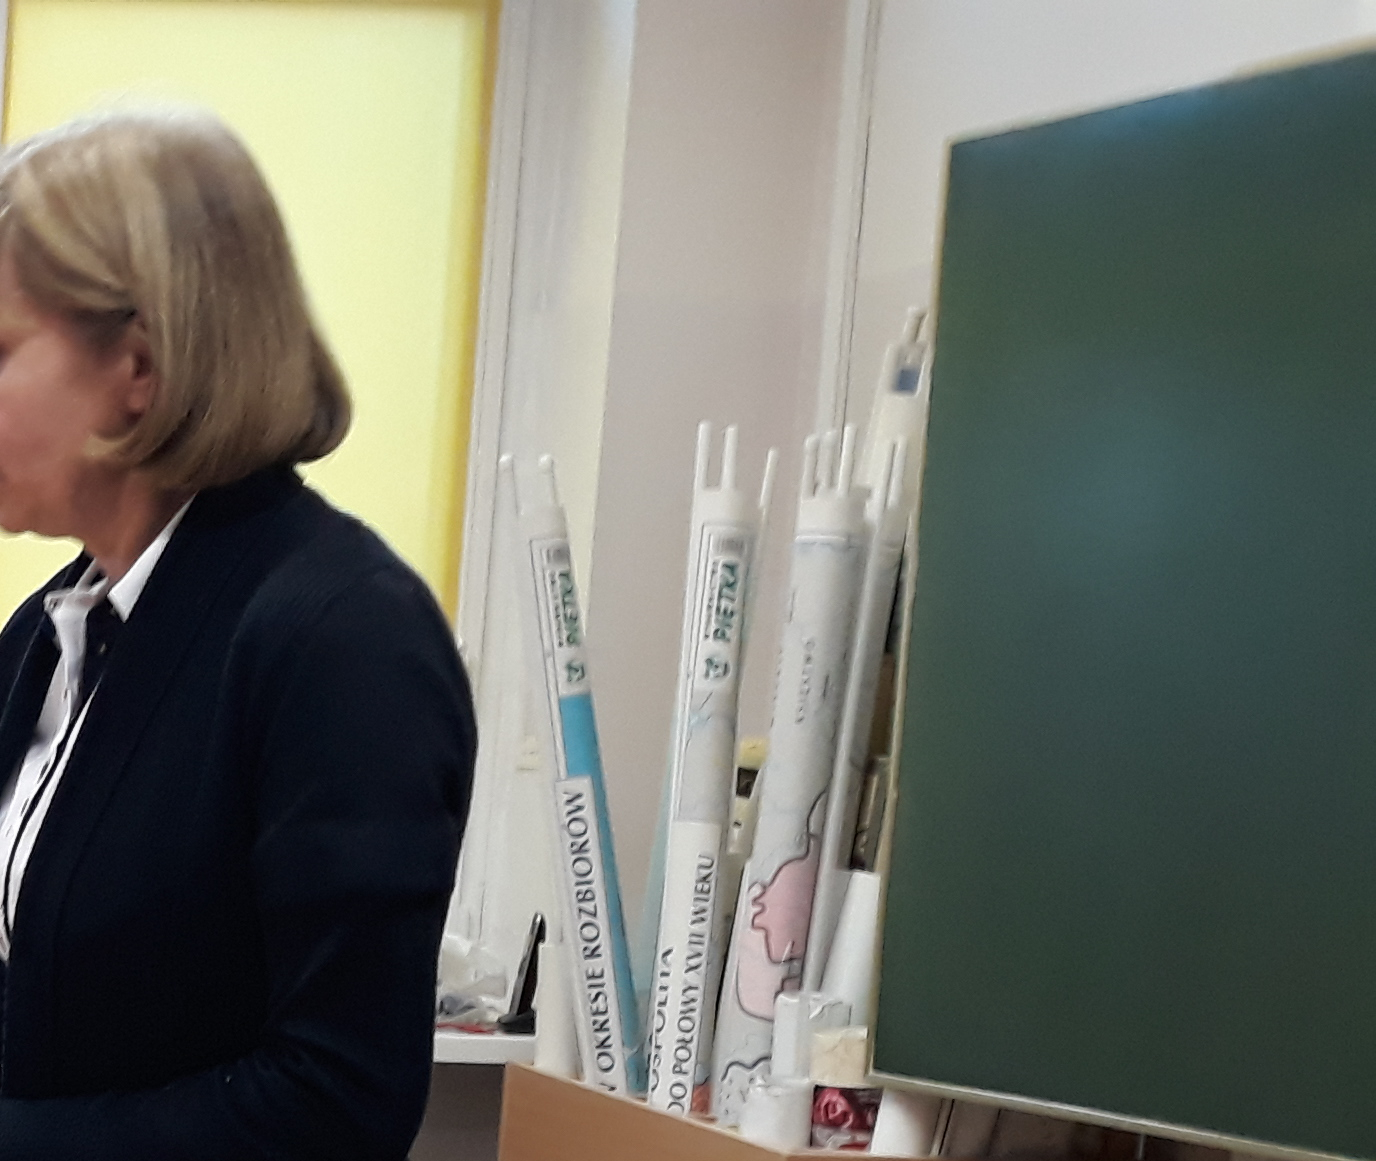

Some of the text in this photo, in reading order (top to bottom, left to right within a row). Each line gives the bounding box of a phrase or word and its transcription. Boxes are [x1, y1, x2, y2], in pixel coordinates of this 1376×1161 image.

[689, 853, 715, 927] WIEKU
[684, 932, 706, 976] XVII
[585, 968, 617, 1073] OKRESIE
[671, 984, 700, 1076] POŁOWY
